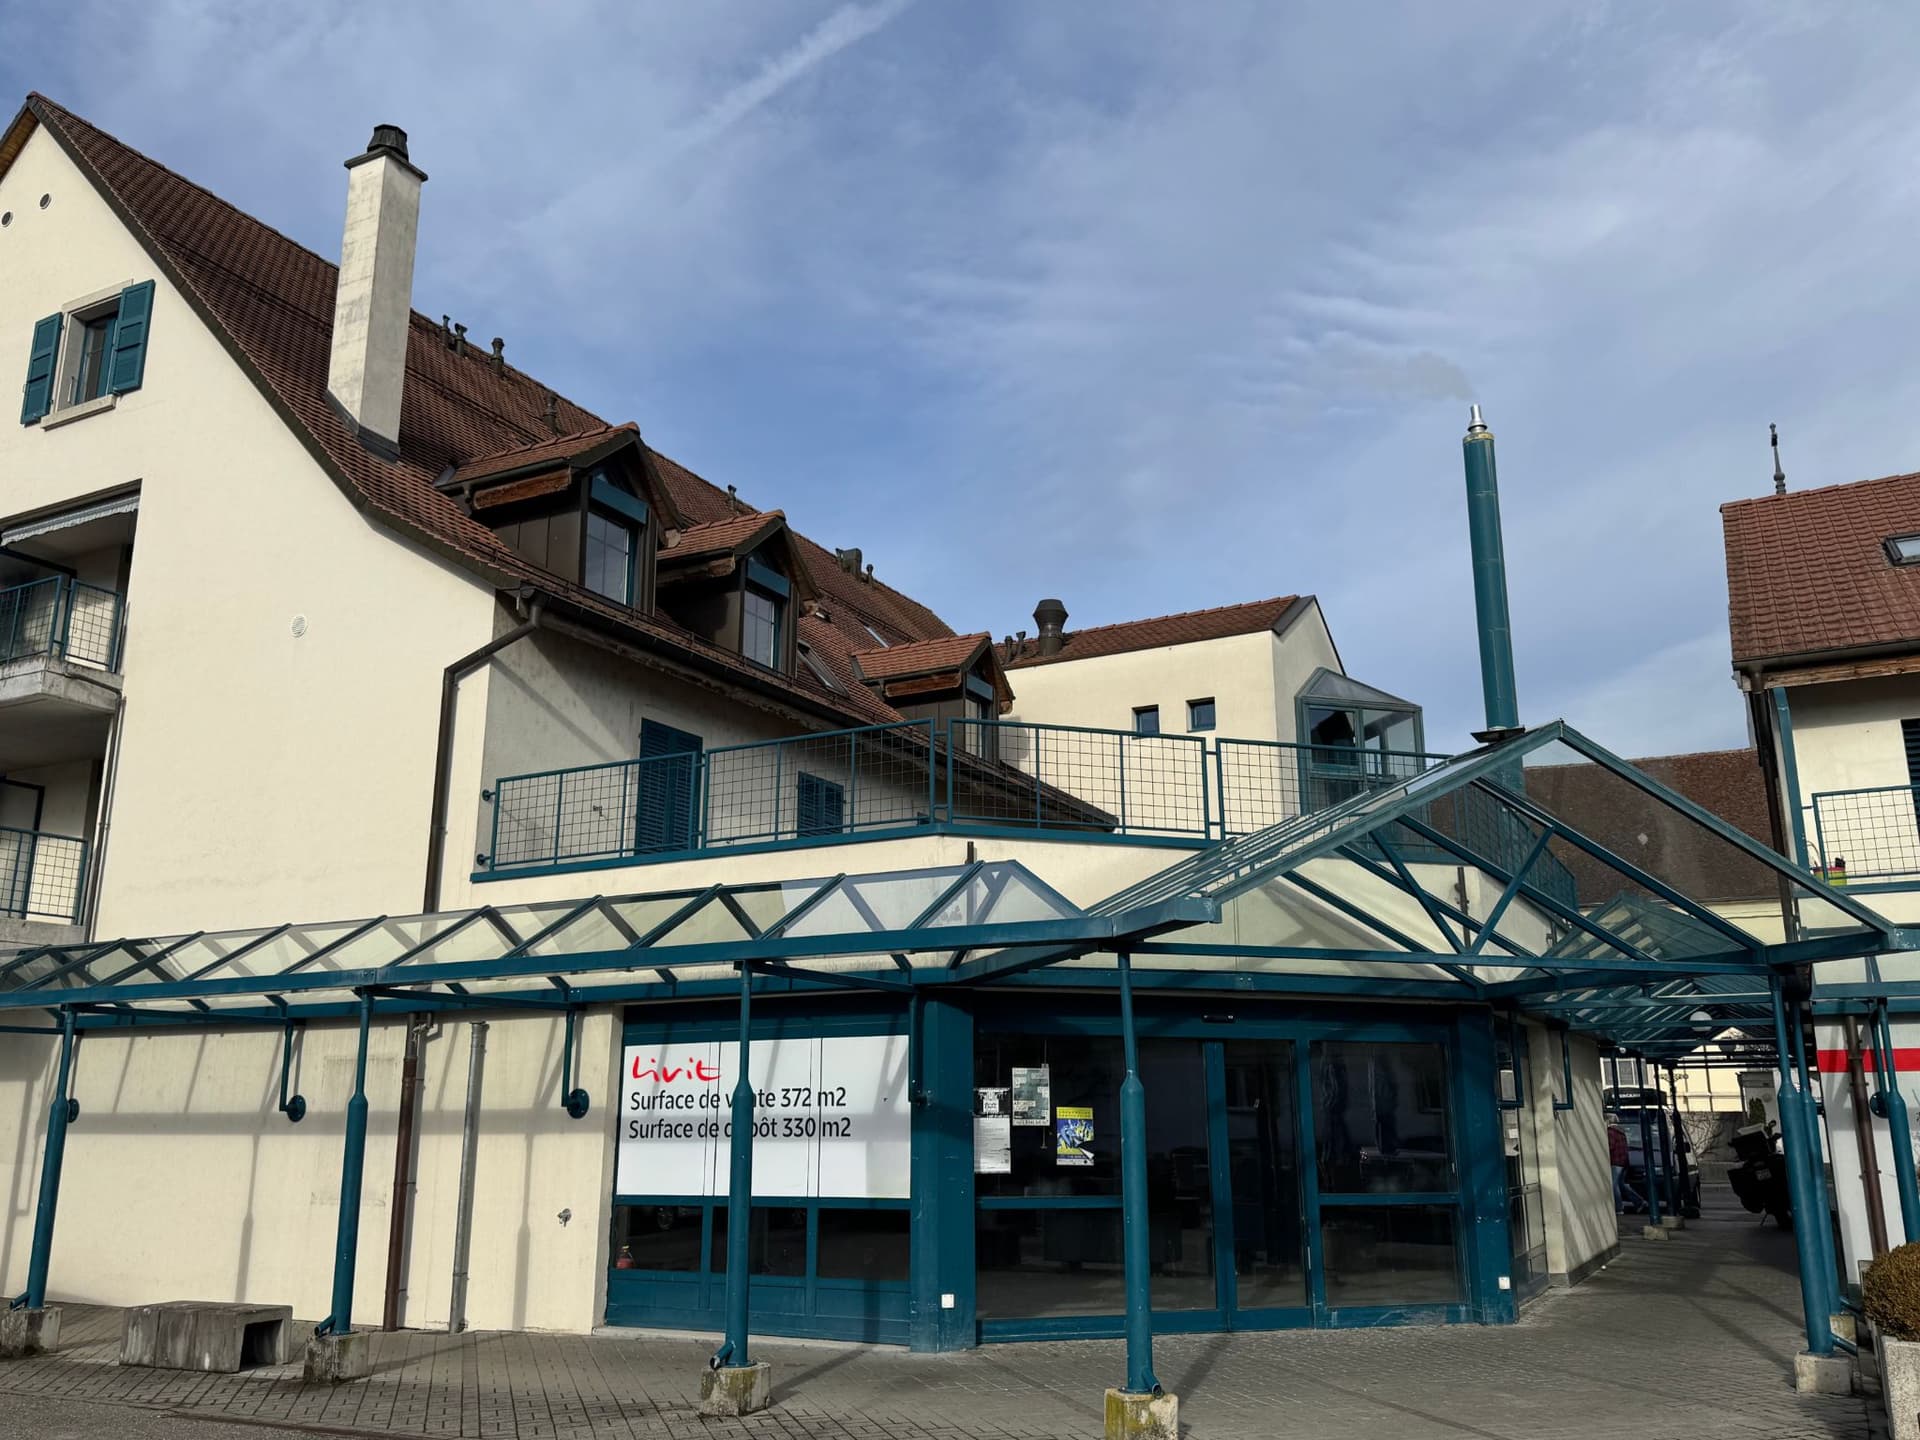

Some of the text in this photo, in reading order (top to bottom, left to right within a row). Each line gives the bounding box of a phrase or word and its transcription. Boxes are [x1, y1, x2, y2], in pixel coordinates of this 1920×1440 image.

[631, 1086, 847, 1110] Surface de vte 372 m2
[629, 1118, 693, 1139] Surface
[697, 1117, 720, 1138] de
[782, 1117, 816, 1138] 330
[822, 1117, 851, 1138] m2
